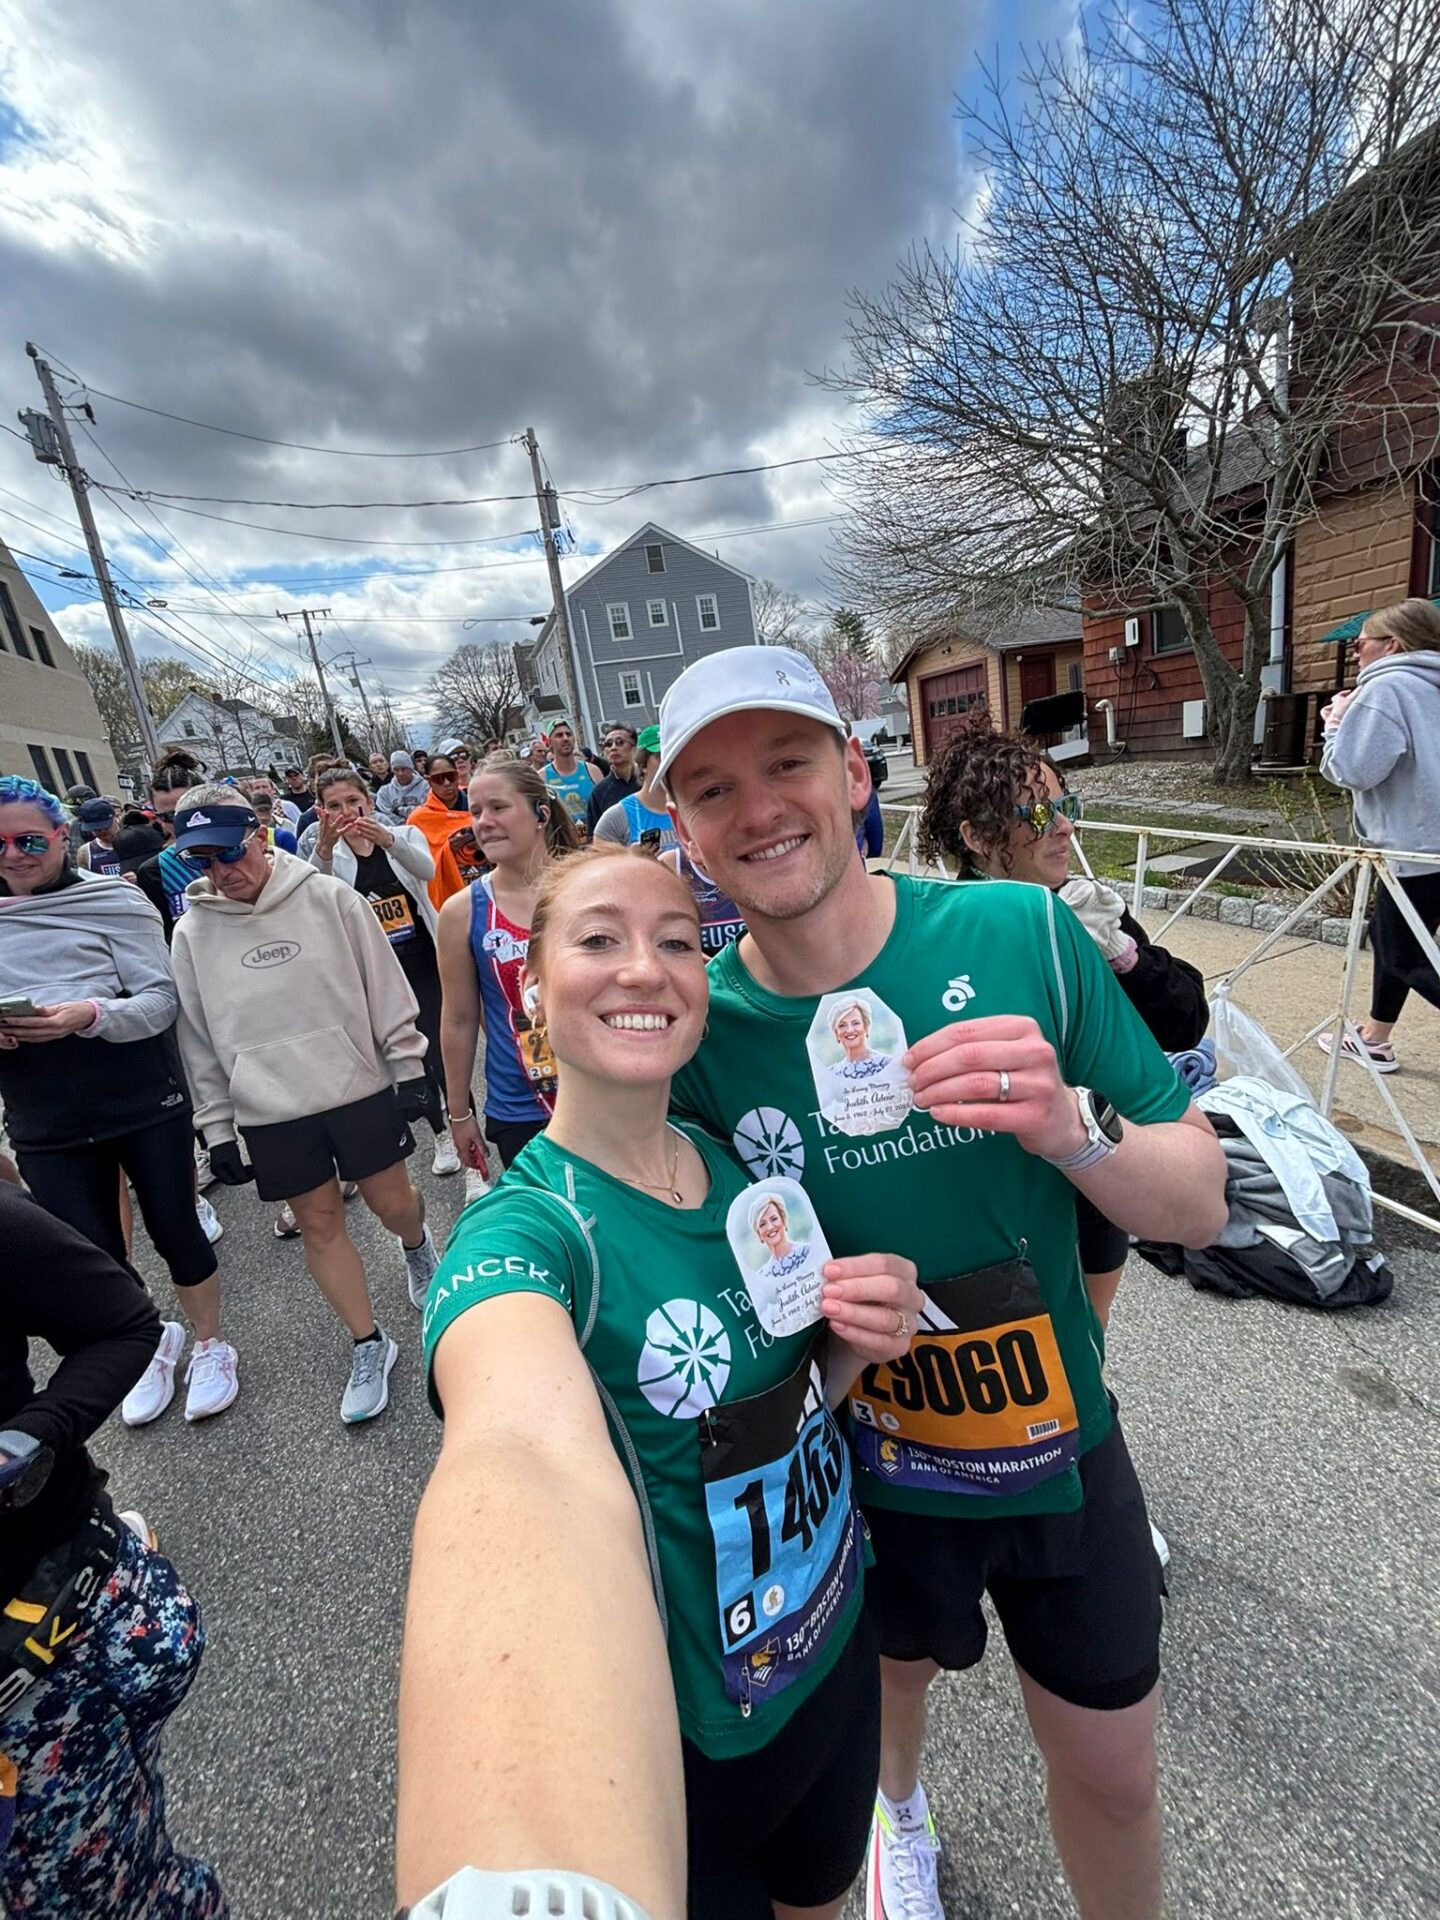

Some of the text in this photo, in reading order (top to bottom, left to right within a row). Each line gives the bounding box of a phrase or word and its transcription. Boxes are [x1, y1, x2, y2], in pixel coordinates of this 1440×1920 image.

[252, 946, 291, 963] Jeep
[856, 1403, 871, 1423] 3
[910, 1461, 1001, 1484] BANK OF AMERICA
[932, 1456, 986, 1475] BOSTON
[988, 1447, 1063, 1475] MARATHON
[810, 1571, 840, 1629] BOSTON
[730, 1600, 751, 1635] 6
